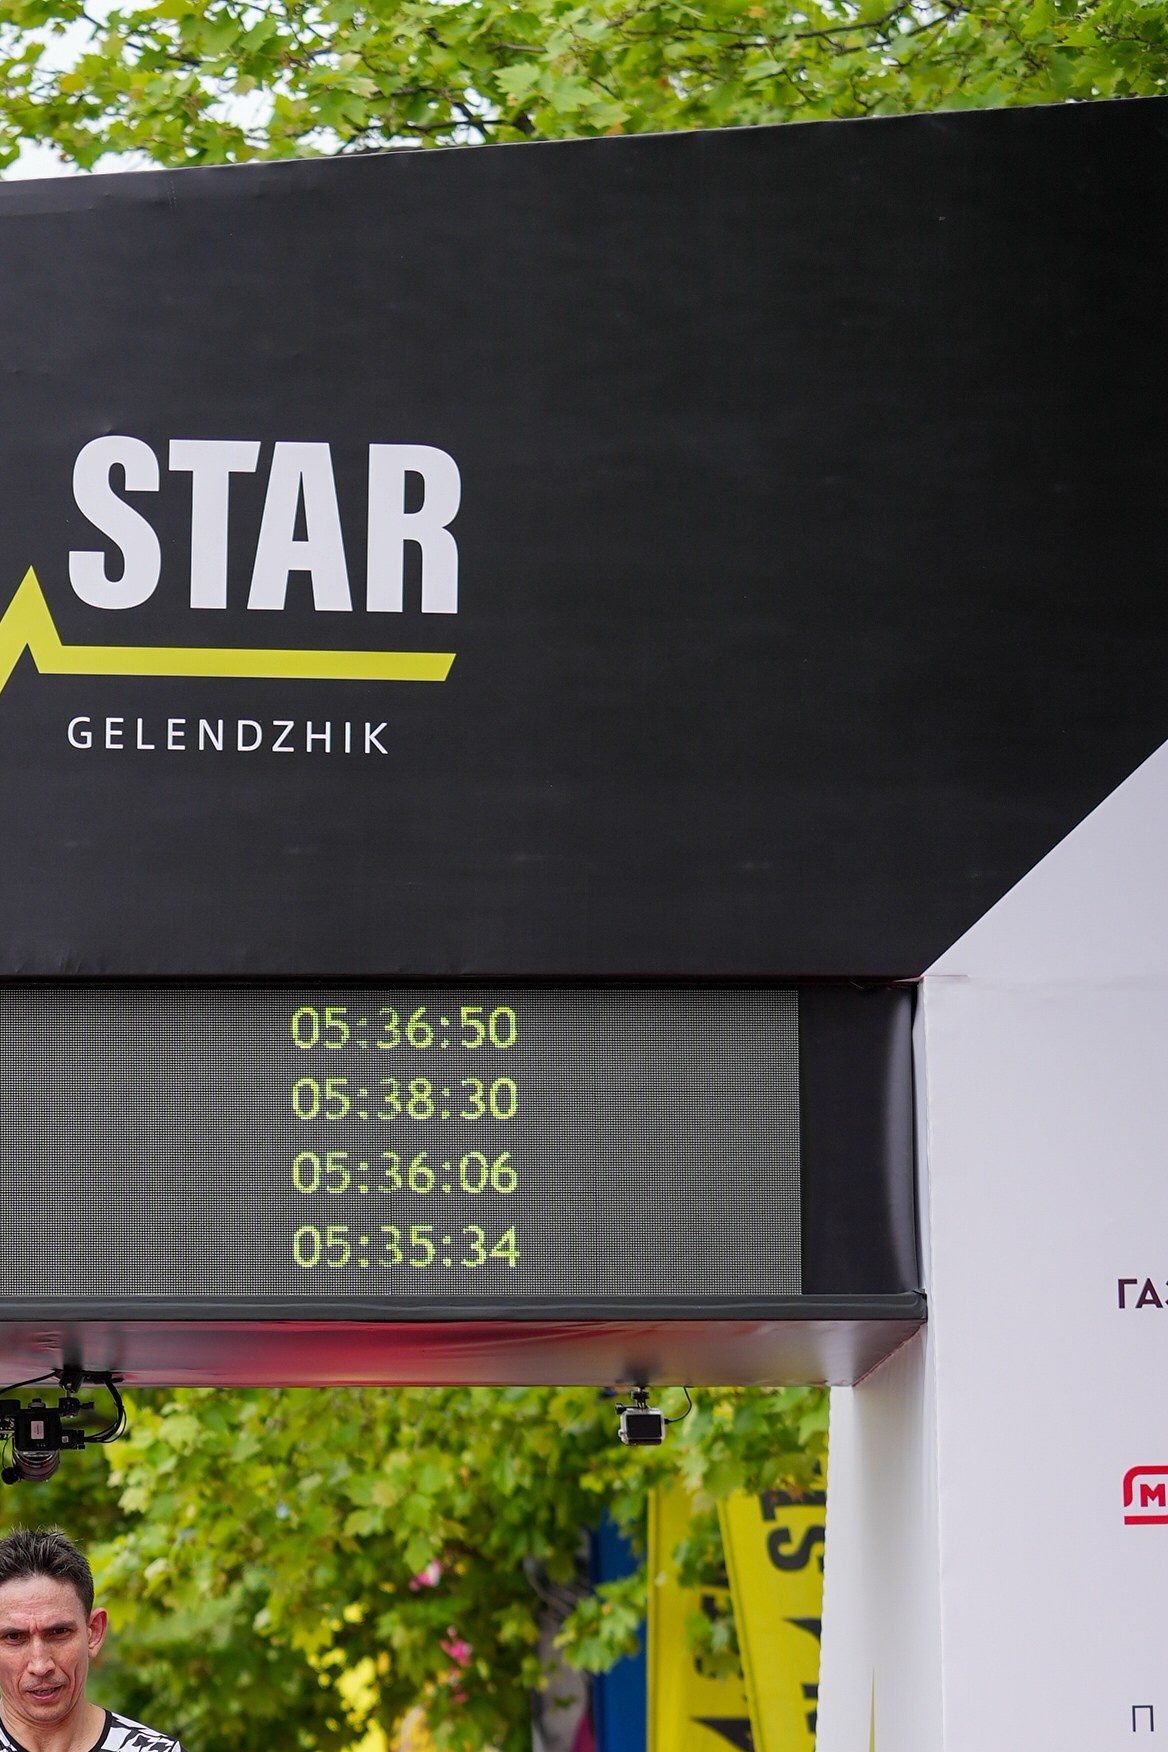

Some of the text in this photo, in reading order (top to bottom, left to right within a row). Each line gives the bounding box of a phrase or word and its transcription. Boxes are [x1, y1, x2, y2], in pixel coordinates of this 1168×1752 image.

[68, 435, 461, 614] STAR
[67, 716, 388, 754] GELENDZHIK
[291, 1006, 518, 1049] 05:36:50
[292, 1076, 518, 1119] 05:38:30
[292, 1151, 518, 1194] 05:36:06
[293, 1224, 521, 1268] 05:35:34
[1117, 1277, 1168, 1309] ГА
